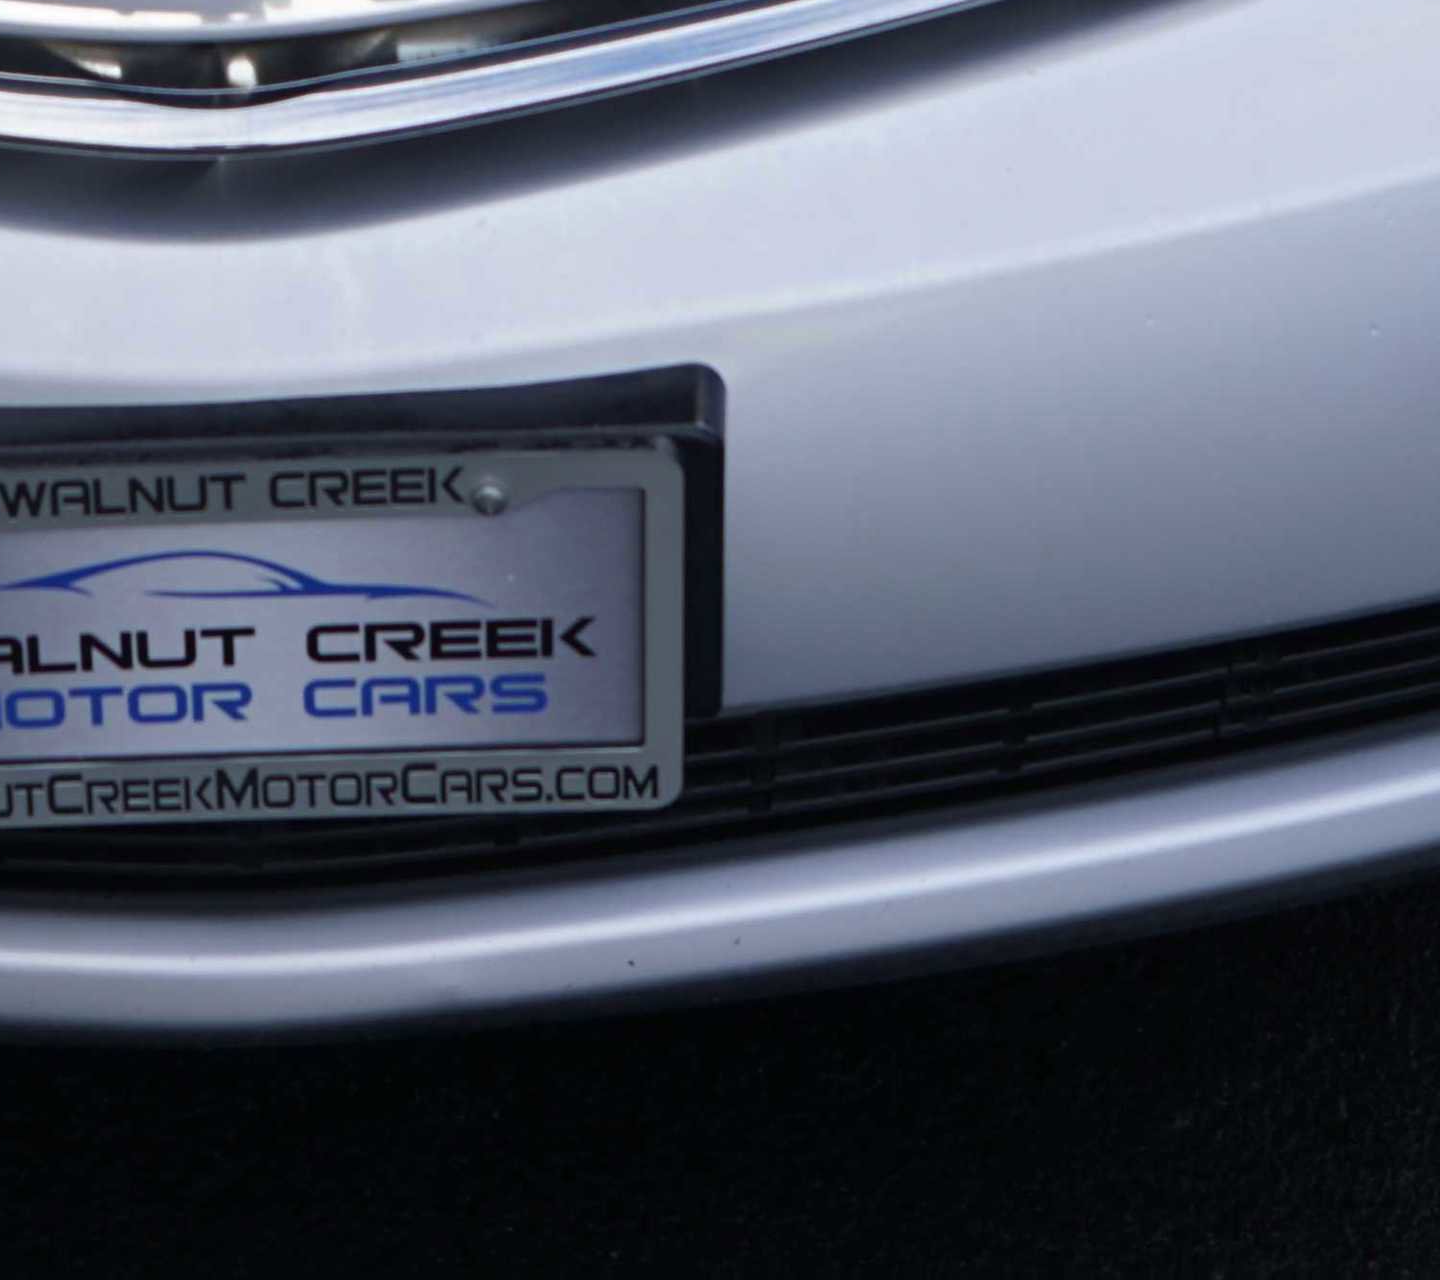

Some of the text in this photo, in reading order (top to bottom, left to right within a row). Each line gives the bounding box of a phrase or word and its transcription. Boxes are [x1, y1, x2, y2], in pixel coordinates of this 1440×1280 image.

[269, 466, 464, 508] CREEK
[306, 616, 596, 663] CREEK
[303, 673, 549, 718] CARS
